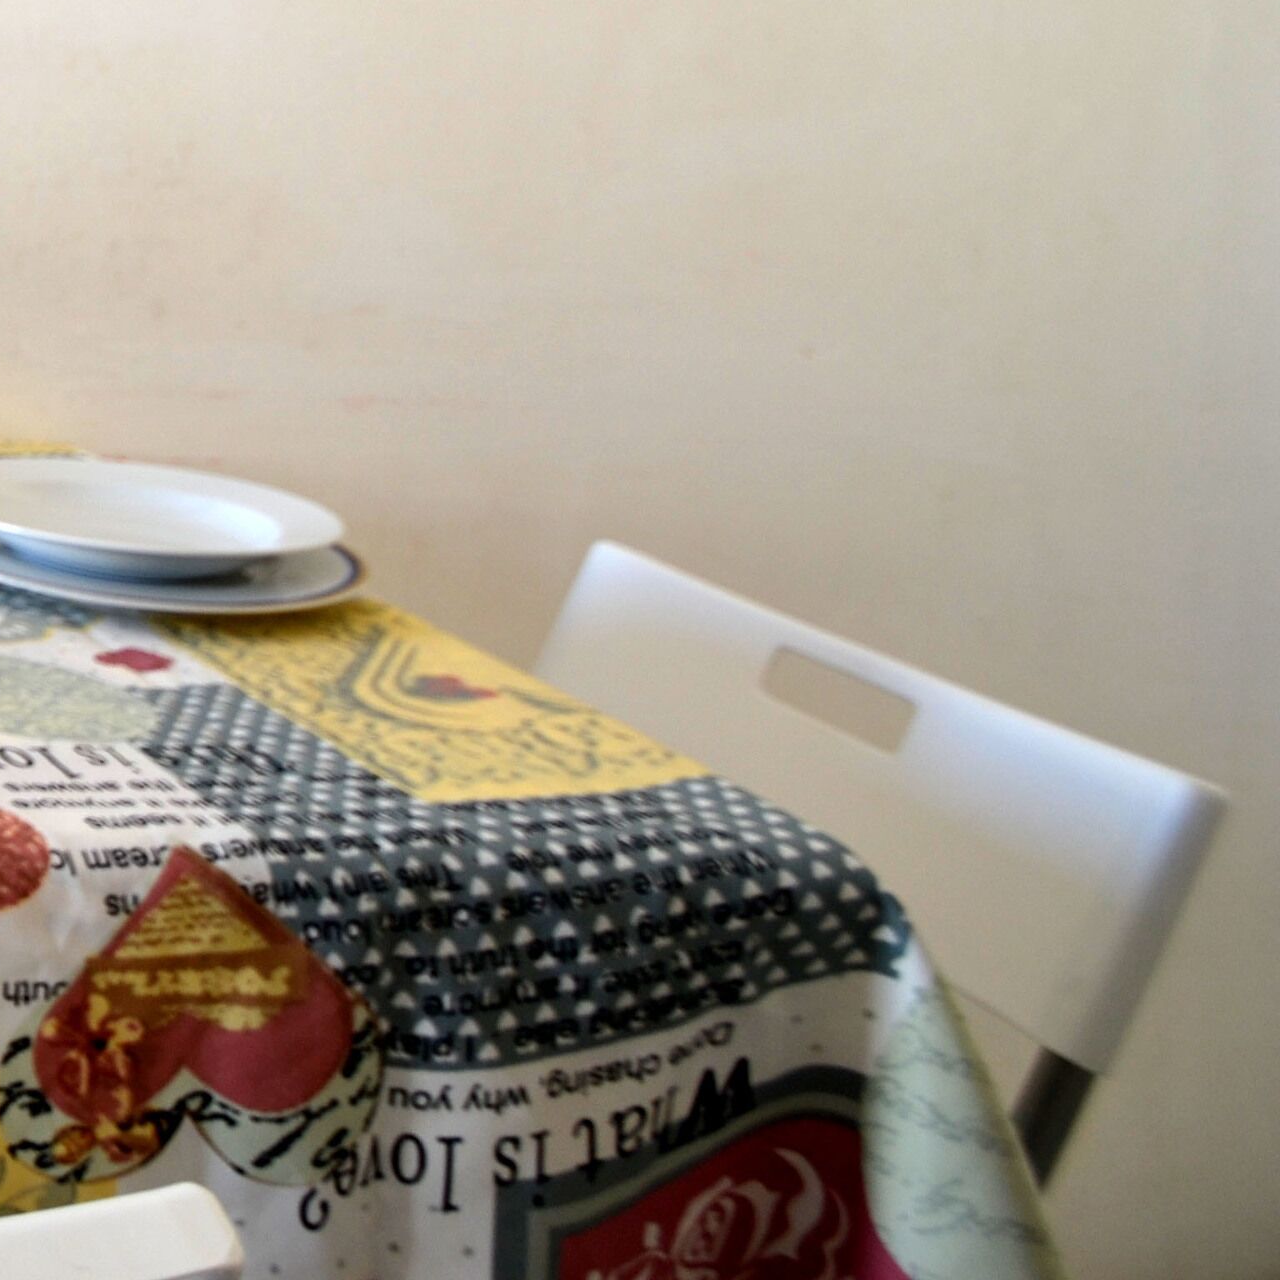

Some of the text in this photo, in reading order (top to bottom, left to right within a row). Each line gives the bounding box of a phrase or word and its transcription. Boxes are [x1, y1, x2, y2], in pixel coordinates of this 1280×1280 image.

[73, 744, 140, 774] is
[387, 1083, 453, 1113] you
[462, 1083, 532, 1118] why
[493, 1128, 552, 1208] is
